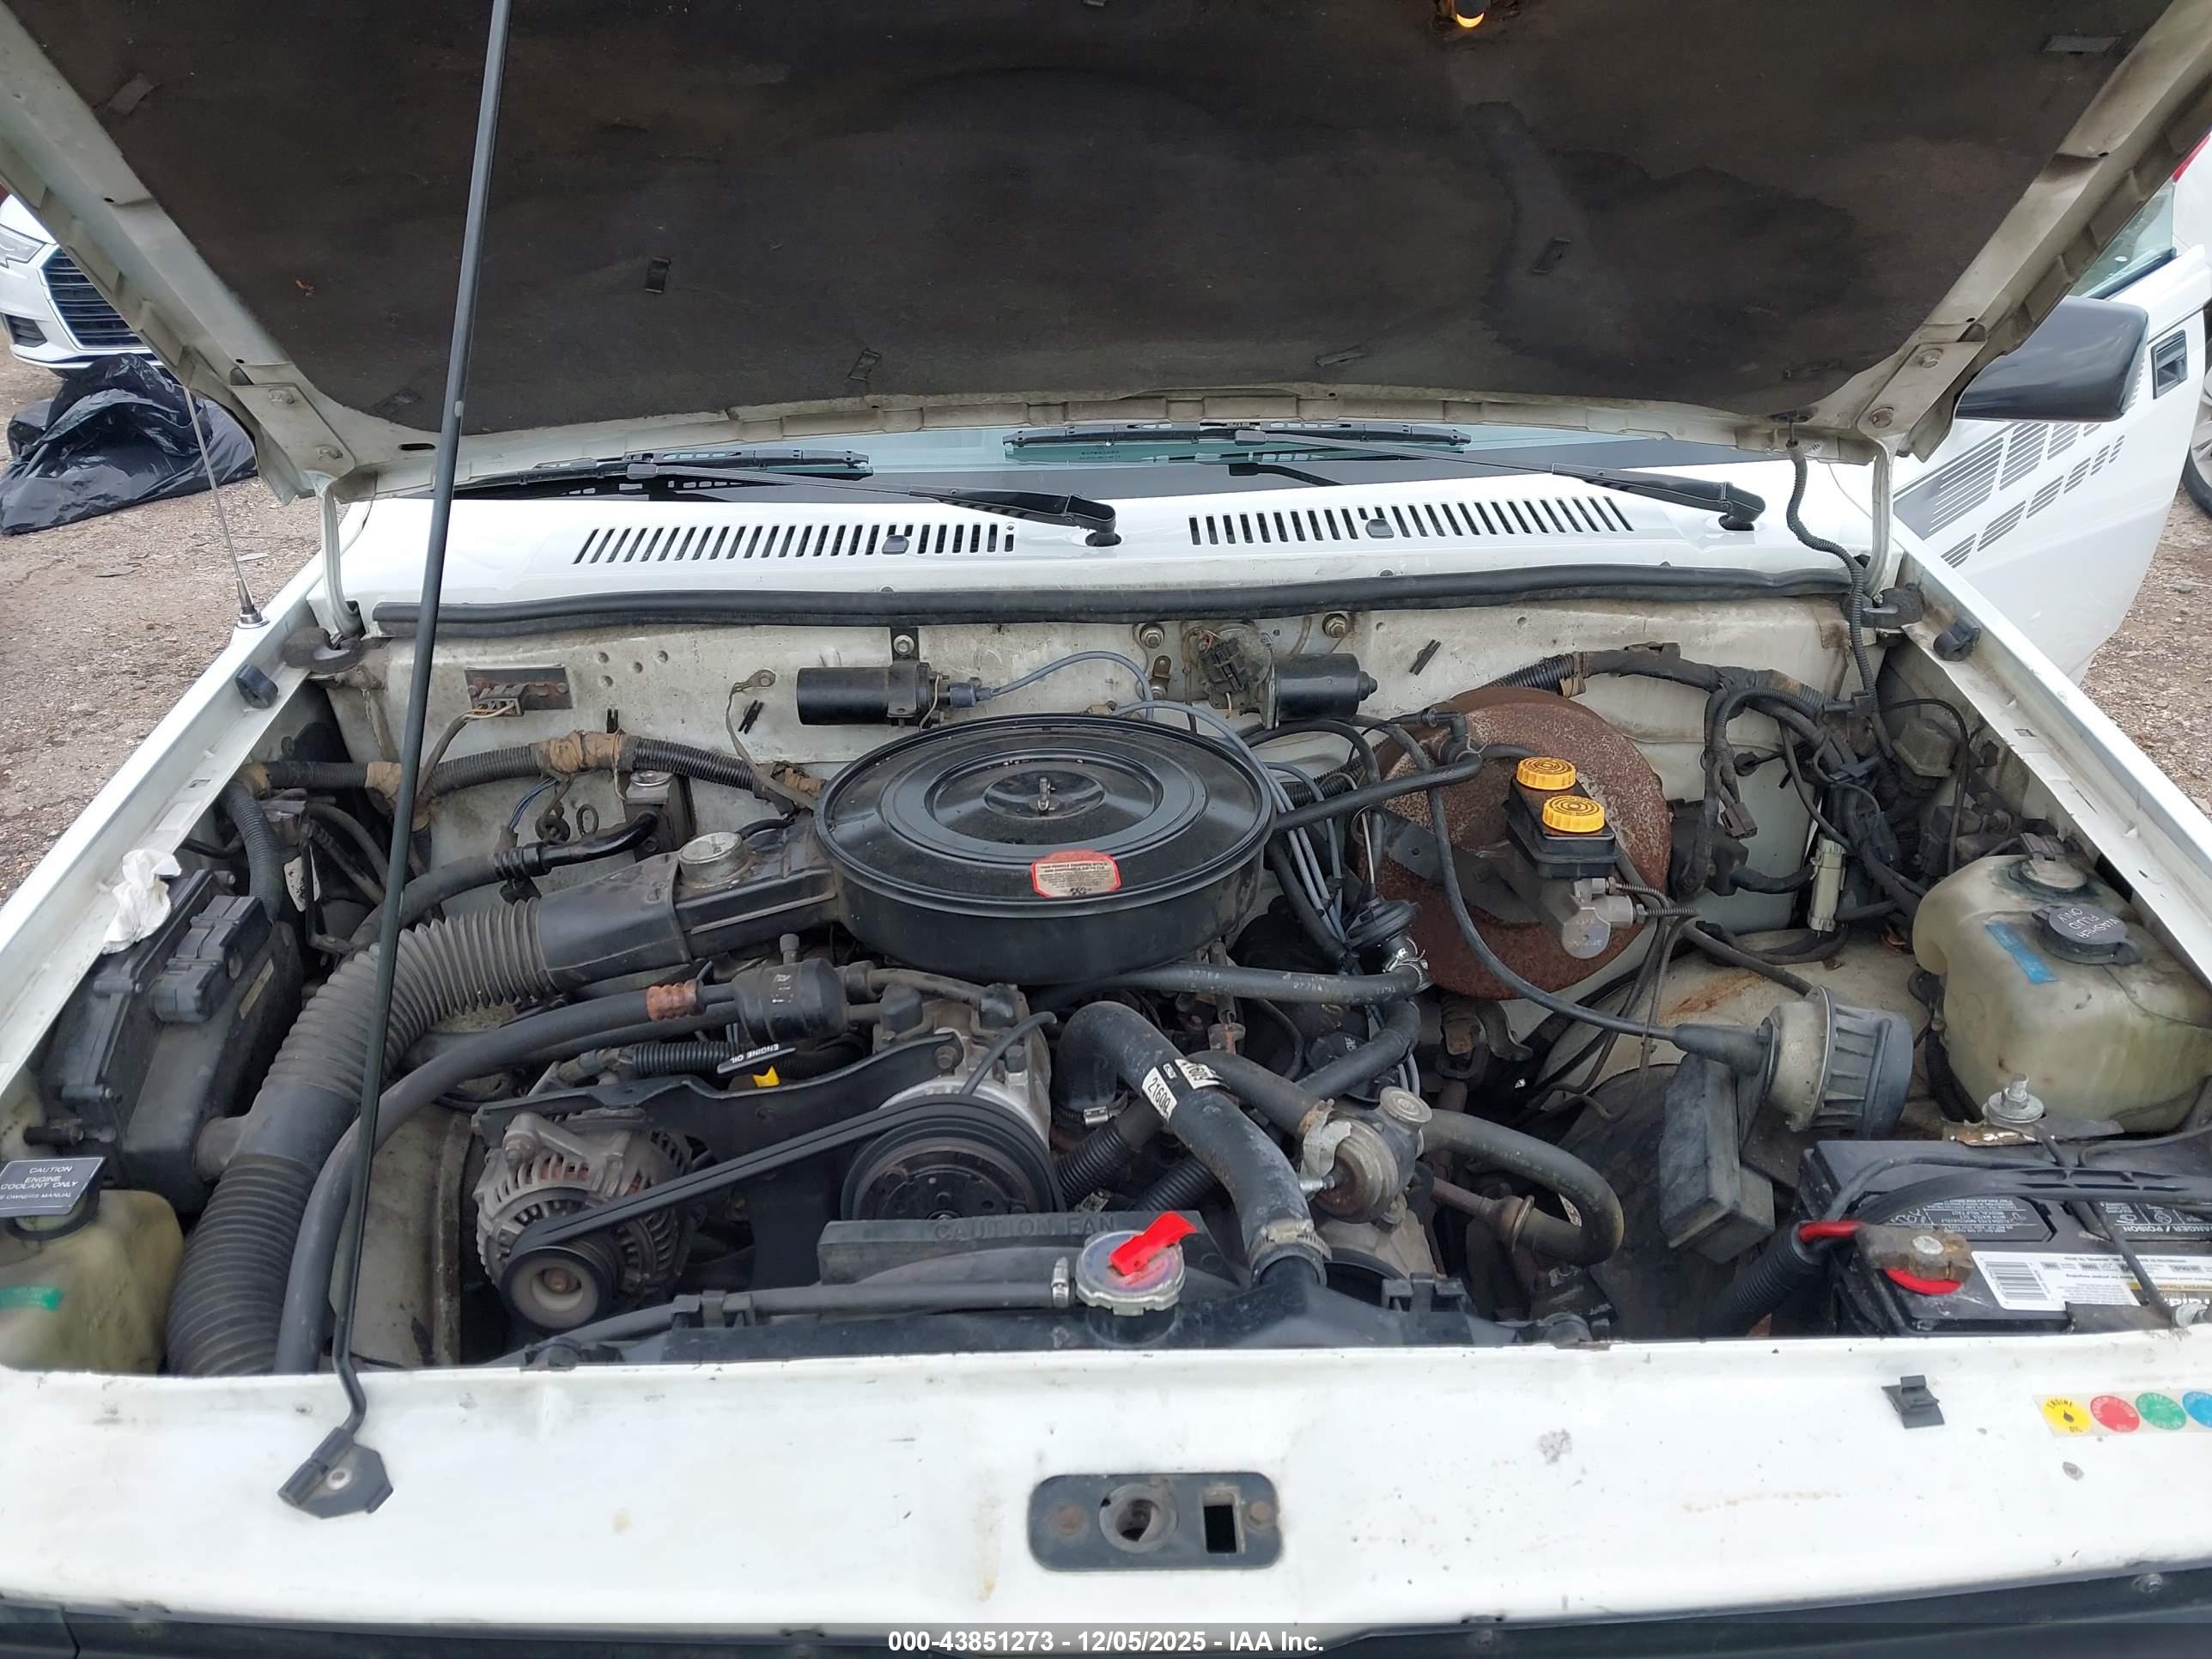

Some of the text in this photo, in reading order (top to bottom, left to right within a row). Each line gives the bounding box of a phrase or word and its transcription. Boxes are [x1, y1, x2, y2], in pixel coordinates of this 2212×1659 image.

[2057, 908, 2083, 922] ONLY
[2068, 914, 2100, 930] FLUID
[2076, 918, 2121, 939] WASHER
[729, 1043, 779, 1064] ENGINE OIL
[934, 1215, 1115, 1240] CAUTION FAN
